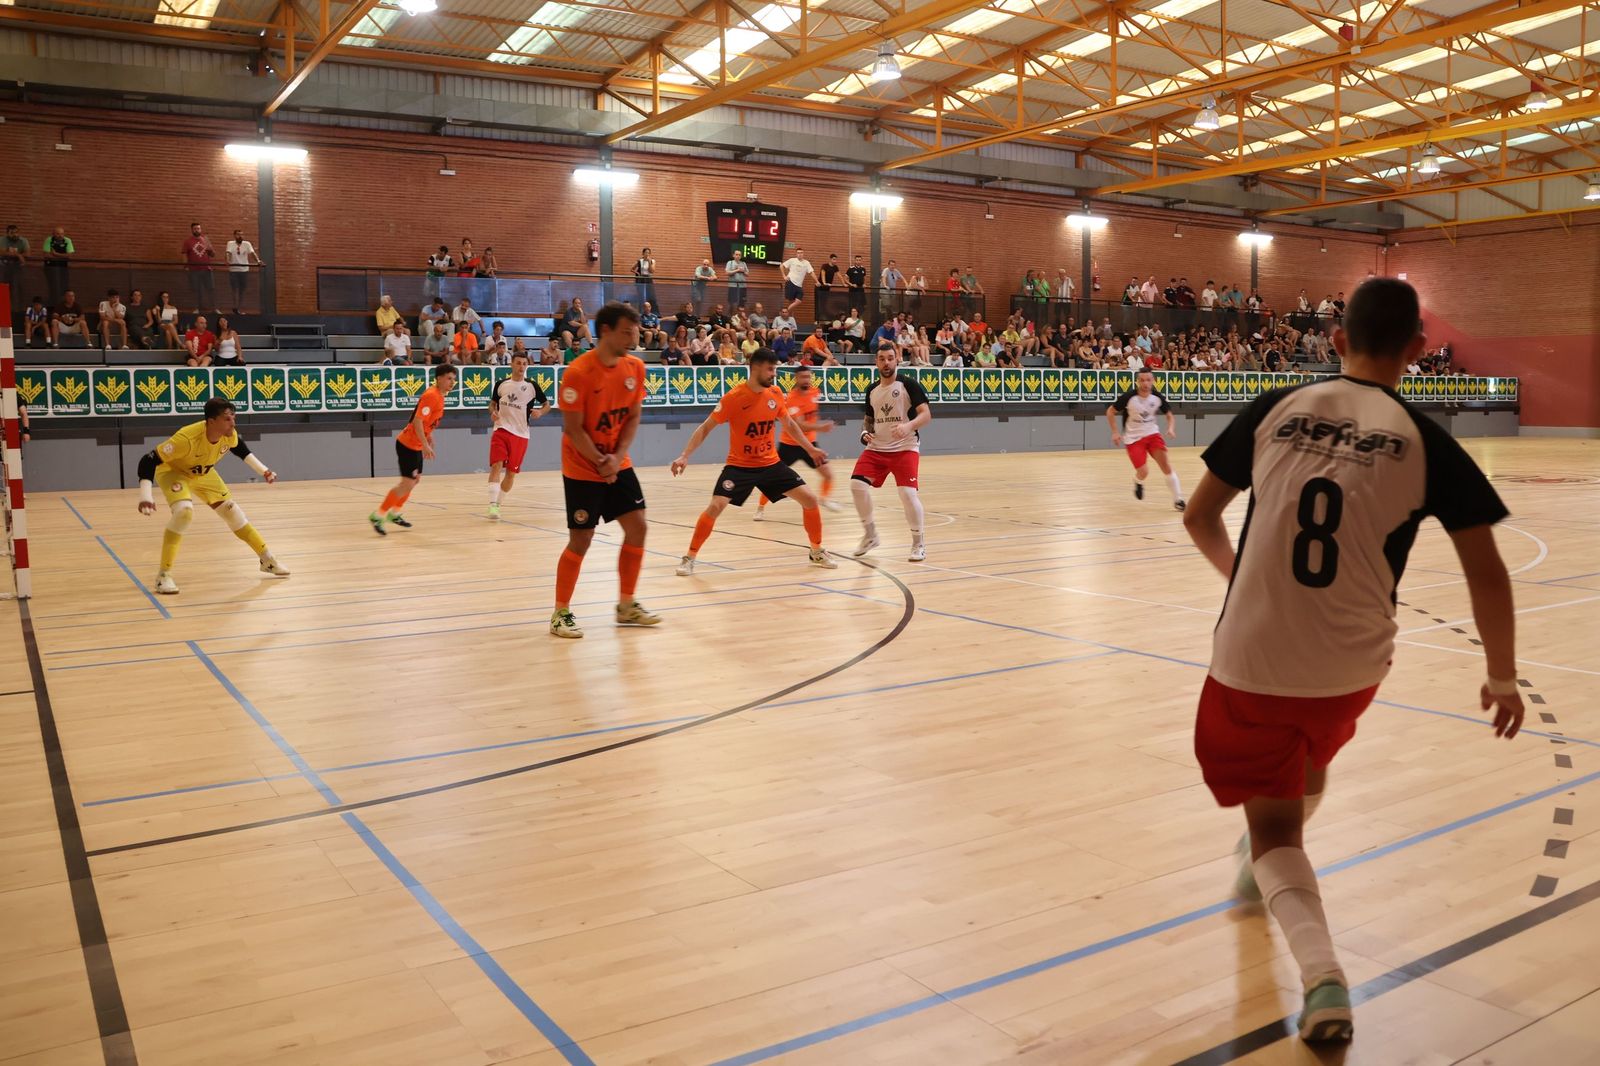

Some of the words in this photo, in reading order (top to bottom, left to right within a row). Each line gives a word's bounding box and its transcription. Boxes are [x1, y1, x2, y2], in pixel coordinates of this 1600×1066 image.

[734, 219, 738, 232] 1
[749, 221, 752, 232] 1
[770, 220, 778, 235] 2
[744, 245, 766, 259] 1:46
[595, 406, 629, 433] ATP
[1292, 477, 1343, 588] 8
